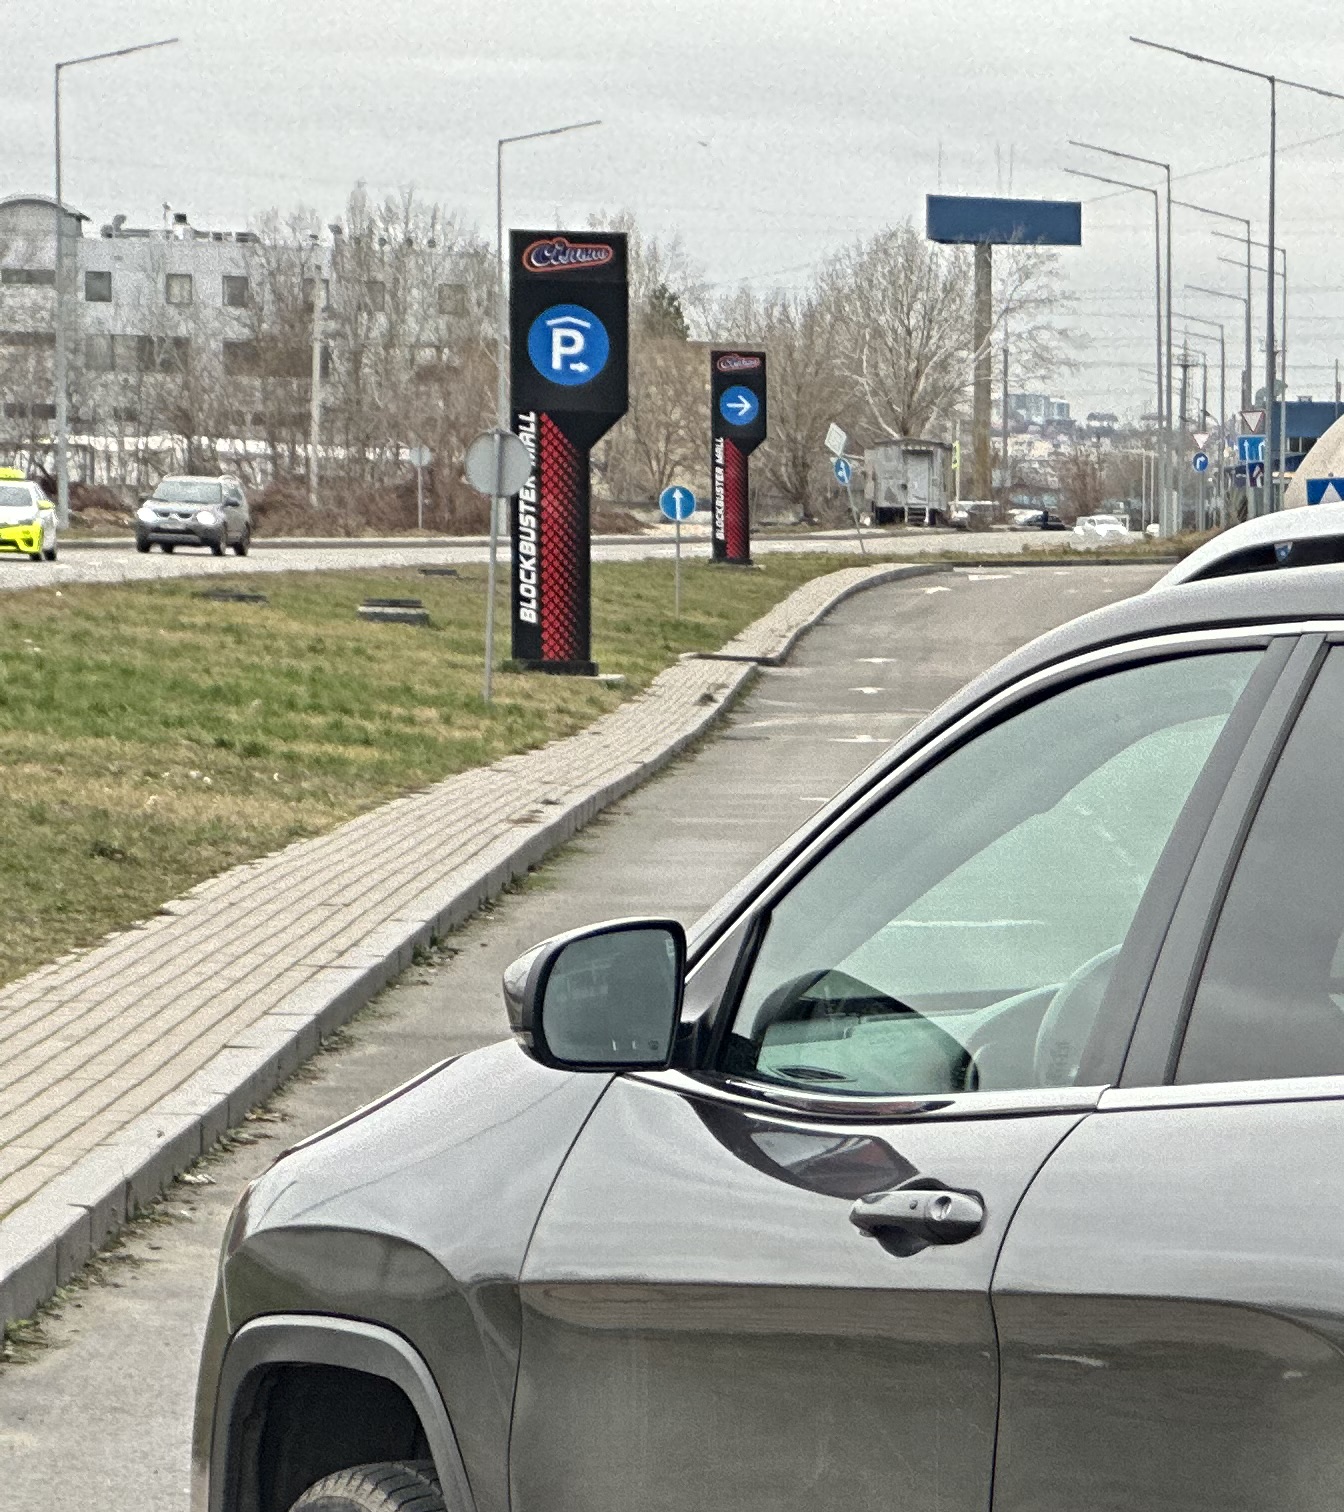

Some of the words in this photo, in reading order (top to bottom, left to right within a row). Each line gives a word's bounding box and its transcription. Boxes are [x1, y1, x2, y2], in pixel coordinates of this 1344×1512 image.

[551, 327, 585, 370] P
[714, 437, 724, 465] MALL
[714, 466, 724, 541] BLOCKBUSTER
